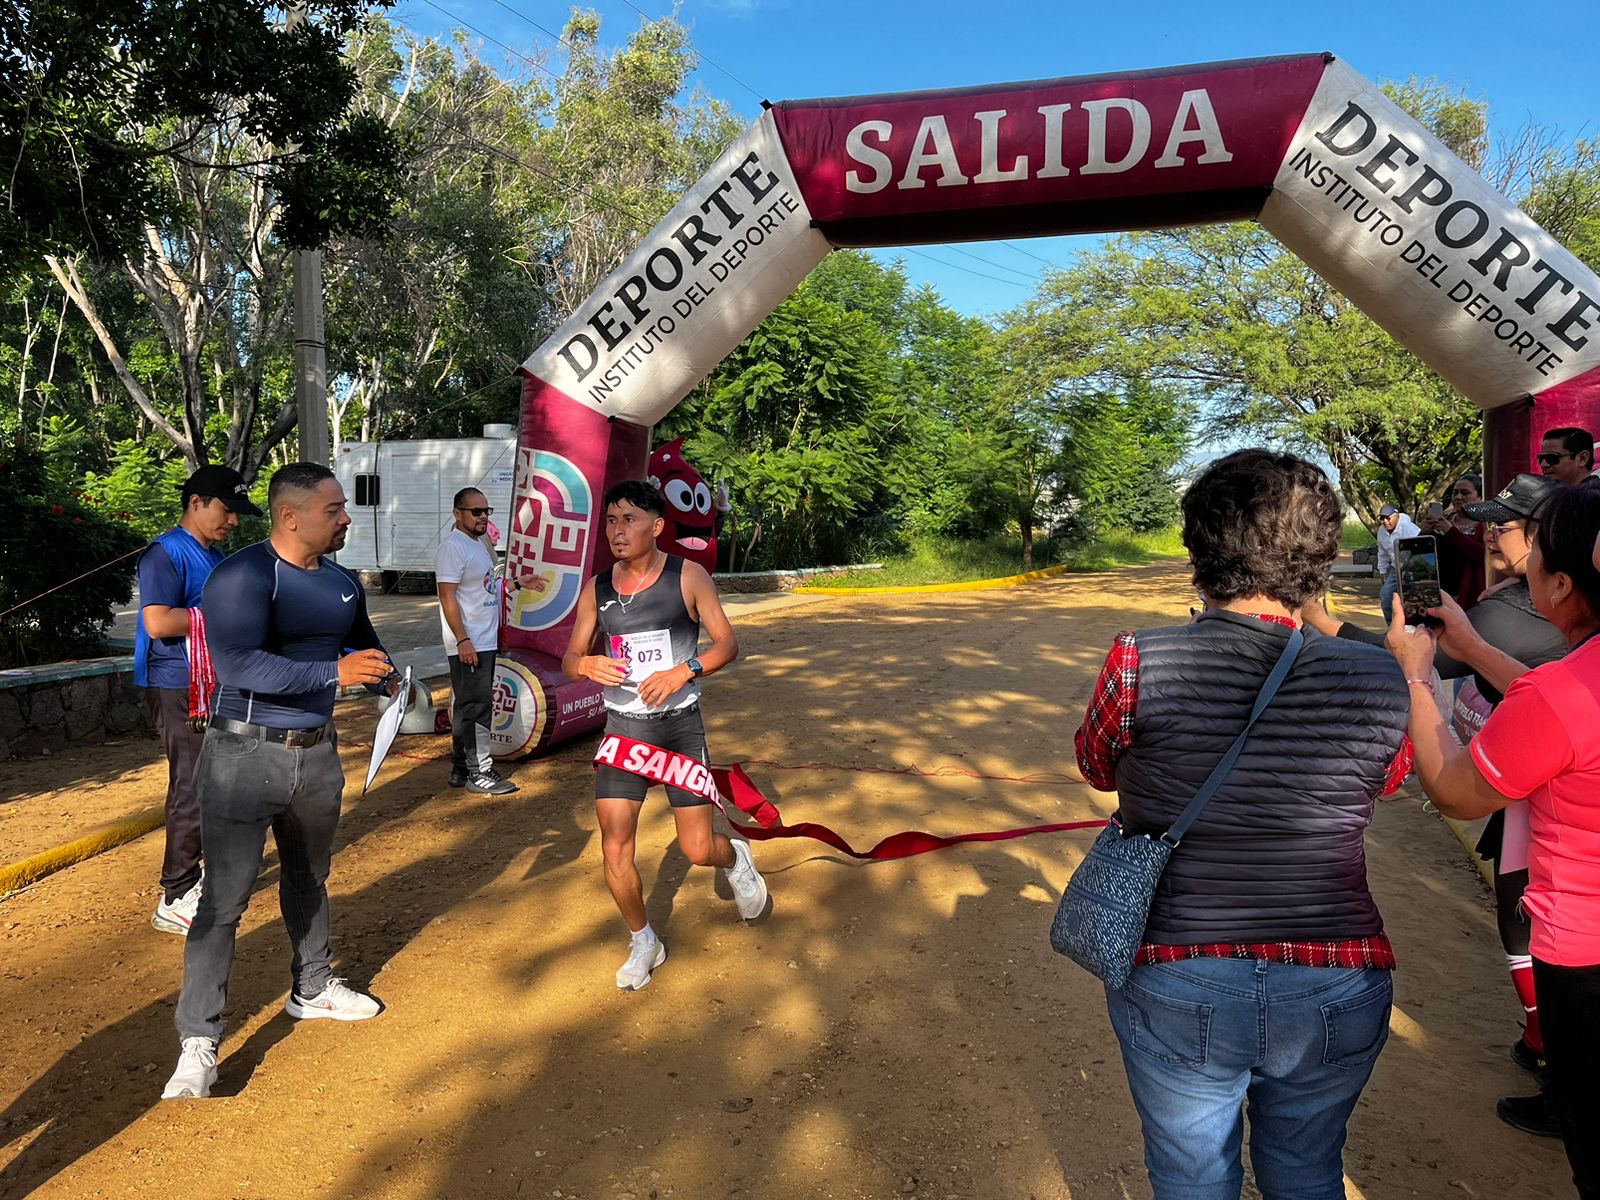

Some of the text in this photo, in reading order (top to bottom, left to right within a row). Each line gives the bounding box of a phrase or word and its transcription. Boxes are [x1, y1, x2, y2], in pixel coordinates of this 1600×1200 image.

[845, 89, 1233, 194] SALIDA
[557, 151, 780, 383] DEPORTE
[1289, 147, 1564, 376] INSTITUTO DEL DEPORTE
[1314, 101, 1600, 352] DEPORTE
[588, 192, 800, 403] INSTITUTO DEL DEPORTE
[562, 702, 574, 714] UN
[574, 693, 601, 711] PUEBLO
[638, 649, 663, 663] 073
[490, 732, 513, 743] RTE
[594, 736, 722, 806] A SANGR
